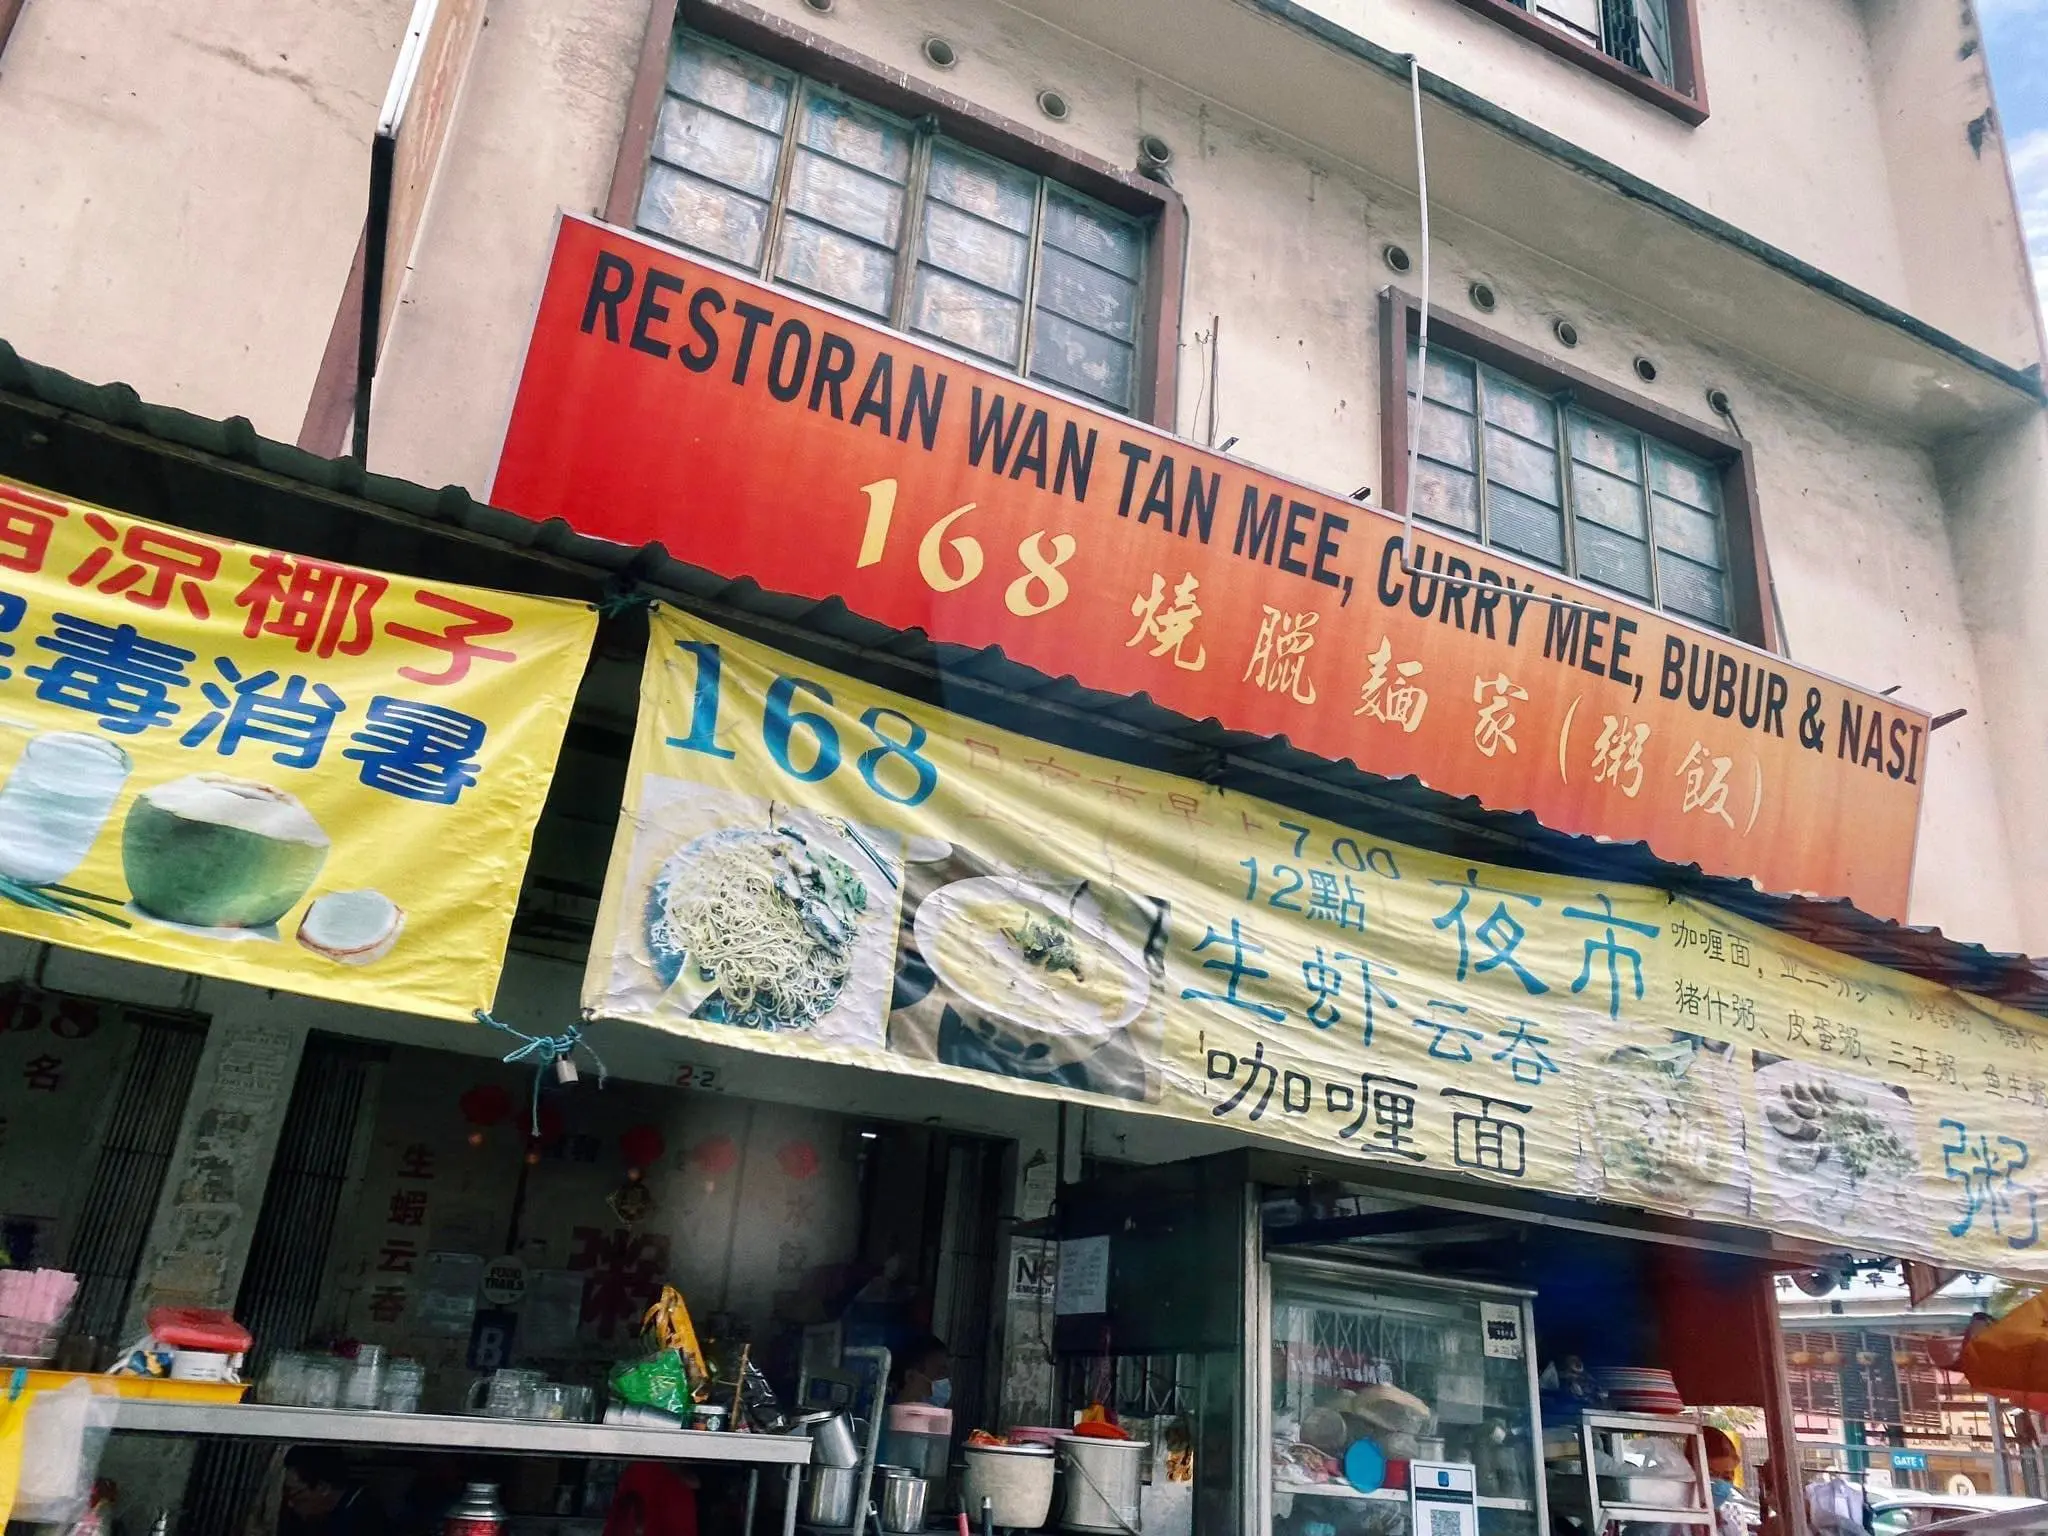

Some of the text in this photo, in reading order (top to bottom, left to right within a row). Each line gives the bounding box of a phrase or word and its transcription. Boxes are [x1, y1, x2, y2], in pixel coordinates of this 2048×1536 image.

[580, 249, 1923, 786] RESTORAN WAN TAN MEE, CURRY MEE, BUBUR & NASI
[856, 477, 1077, 618] 168
[665, 639, 938, 808] 168
[1181, 917, 1560, 1087] 生虾云吞
[1427, 868, 1662, 1022] 夜市
[1205, 1041, 1533, 1178] 咖喱面
[1939, 1117, 2040, 1250] 粥
[1893, 1454, 1925, 1468] GATE 1
